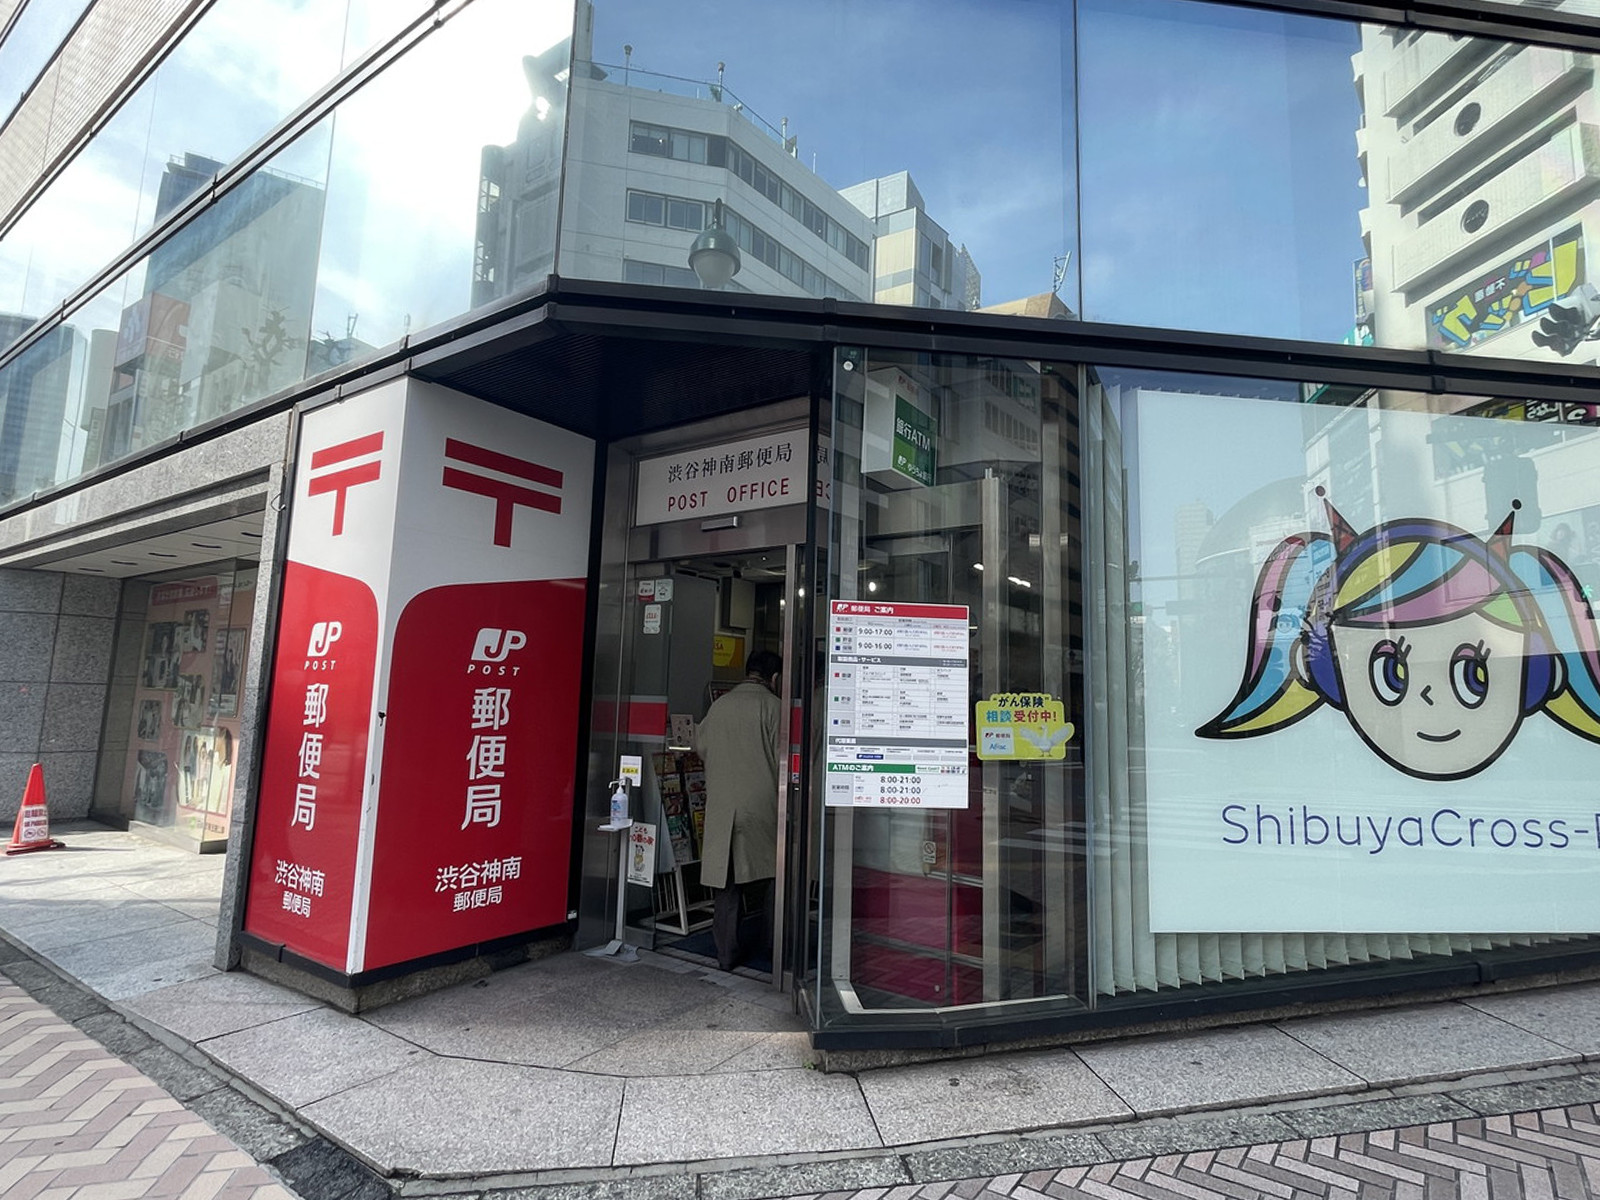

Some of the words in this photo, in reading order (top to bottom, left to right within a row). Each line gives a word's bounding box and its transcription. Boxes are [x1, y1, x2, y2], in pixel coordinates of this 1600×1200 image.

[896, 417, 931, 451] 銀行ATM
[667, 442, 793, 484] 渋谷神南郵便局
[667, 491, 709, 512] POST
[726, 477, 790, 503] OFFICE
[307, 621, 342, 657] JP
[471, 628, 527, 662] JP
[304, 660, 336, 671] POST
[467, 664, 520, 676] POST
[290, 683, 330, 831] 郵便局
[460, 687, 512, 831] 郵便局
[880, 775, 922, 784] 8:00-21:00
[880, 786, 921, 794] 8:00-21:00
[880, 796, 921, 804] 8:00-20:00
[274, 859, 326, 898] 渋谷神南
[434, 855, 523, 893] 渋谷神南
[282, 890, 312, 919] 郵便局
[452, 885, 503, 912] 郵便局
